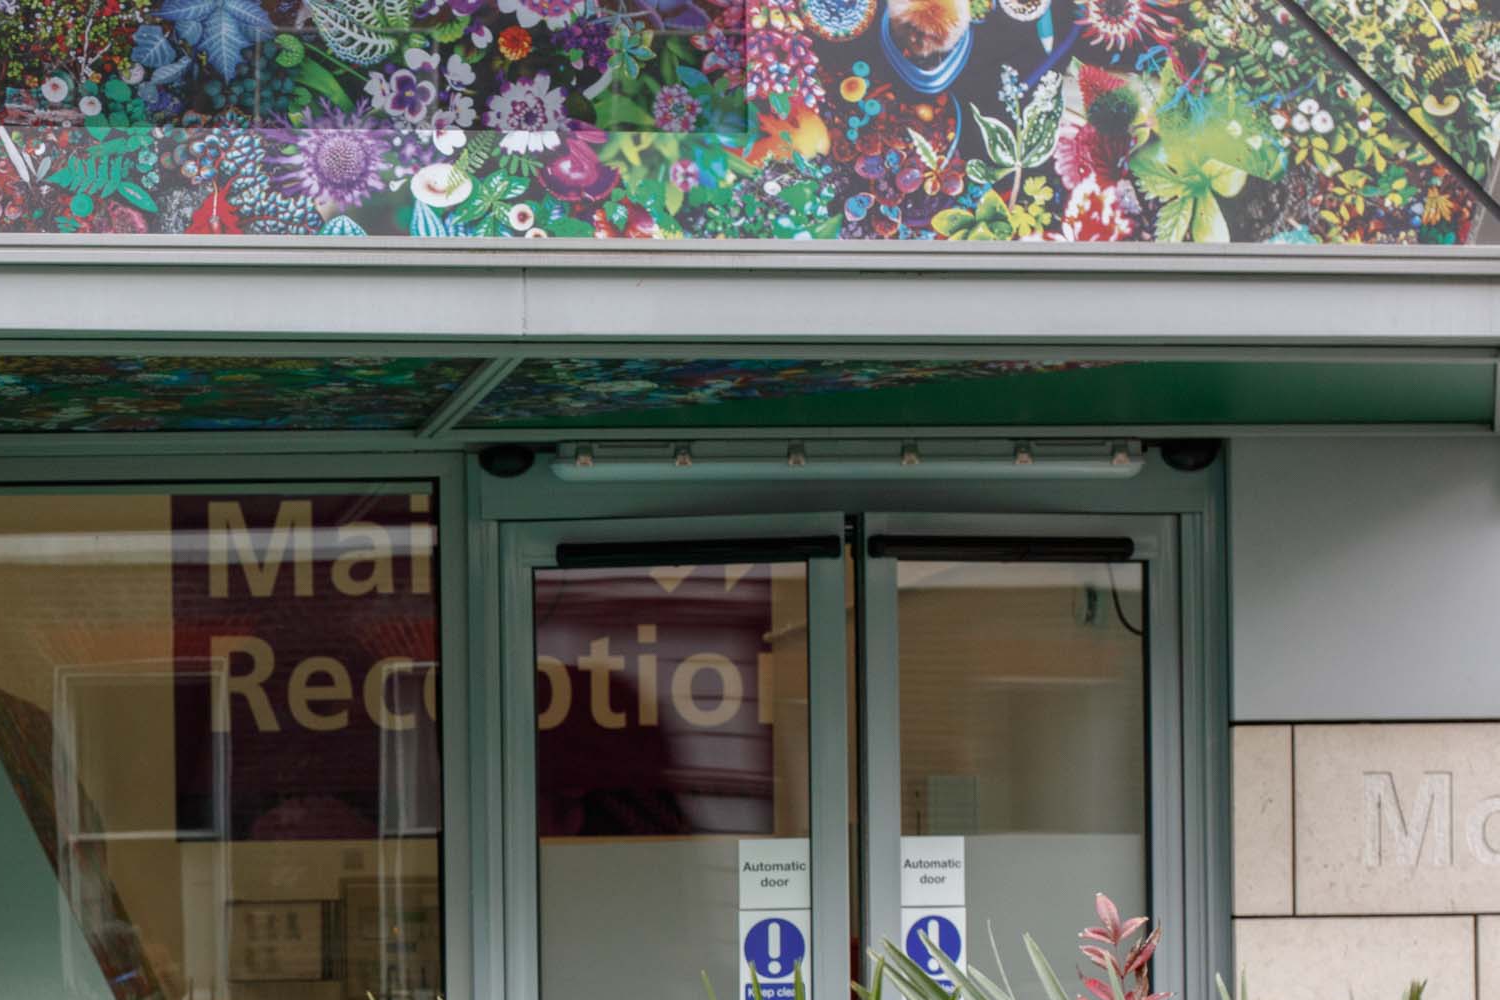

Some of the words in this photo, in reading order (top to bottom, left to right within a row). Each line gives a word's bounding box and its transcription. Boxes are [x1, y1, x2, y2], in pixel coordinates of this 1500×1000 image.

[207, 494, 433, 598] Mai
[743, 861, 806, 872] Automatic
[904, 858, 961, 869] Automatic
[760, 877, 789, 888] door
[919, 874, 946, 884] door
[747, 987, 775, 1000] Kep
